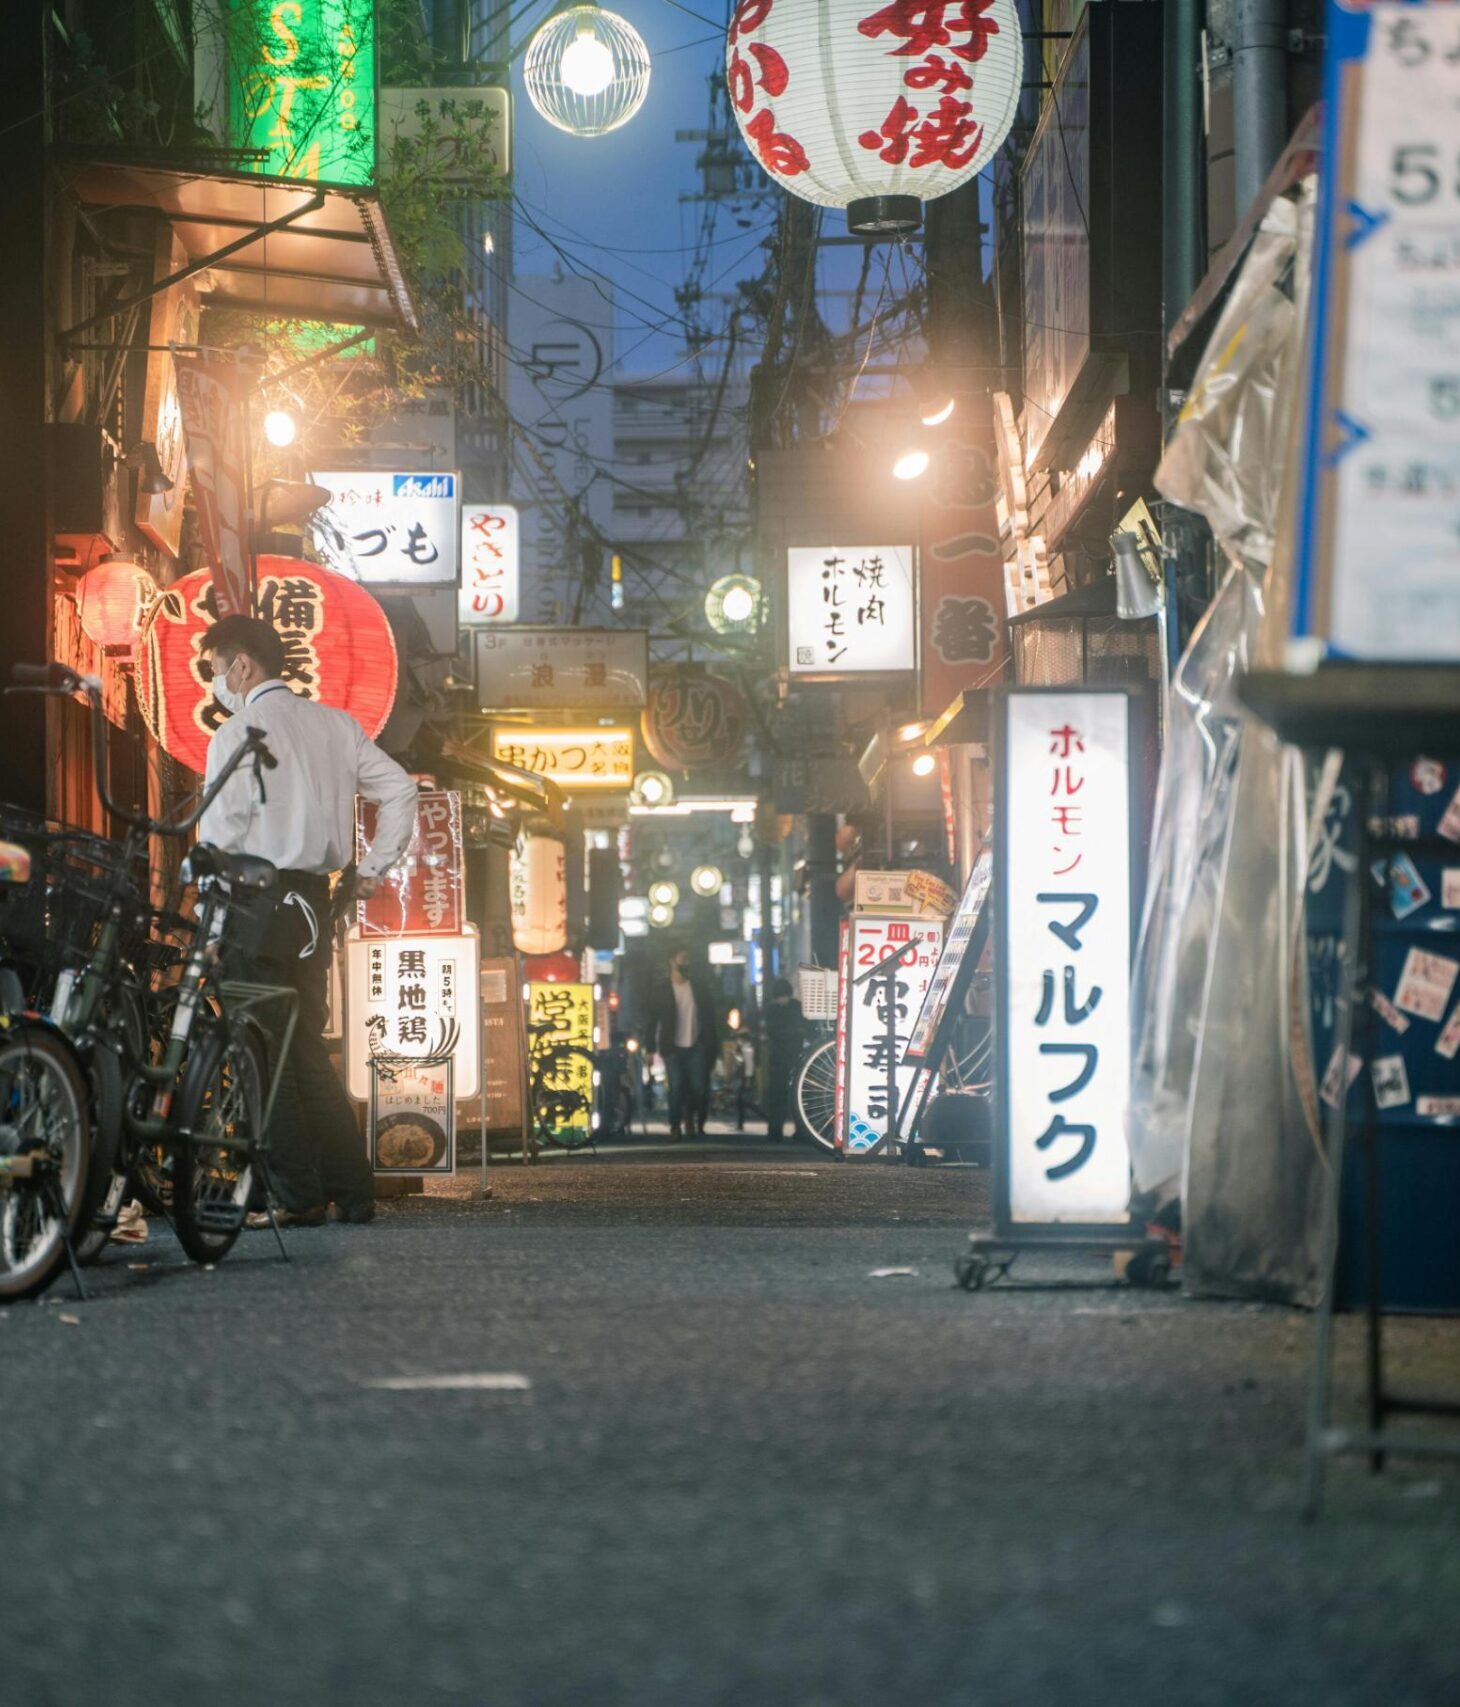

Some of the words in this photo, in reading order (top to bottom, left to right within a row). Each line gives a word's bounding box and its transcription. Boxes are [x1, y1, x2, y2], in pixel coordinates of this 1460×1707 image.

[396, 476, 449, 497] Asahi
[469, 513, 505, 617] やきとり
[853, 556, 888, 625] 焼肉
[822, 555, 848, 663] ホルモン
[498, 744, 587, 772] 串かつ
[1050, 724, 1085, 876] ホルモン
[420, 801, 450, 928] やってます
[858, 943, 929, 968] 200円
[859, 923, 910, 942] 一皿
[372, 949, 383, 997] 年中無休
[398, 950, 427, 1045] 黒地鶏
[1035, 892, 1102, 1181] マルフク
[384, 1095, 441, 1105] はじめました
[422, 1105, 447, 1116] 700円
